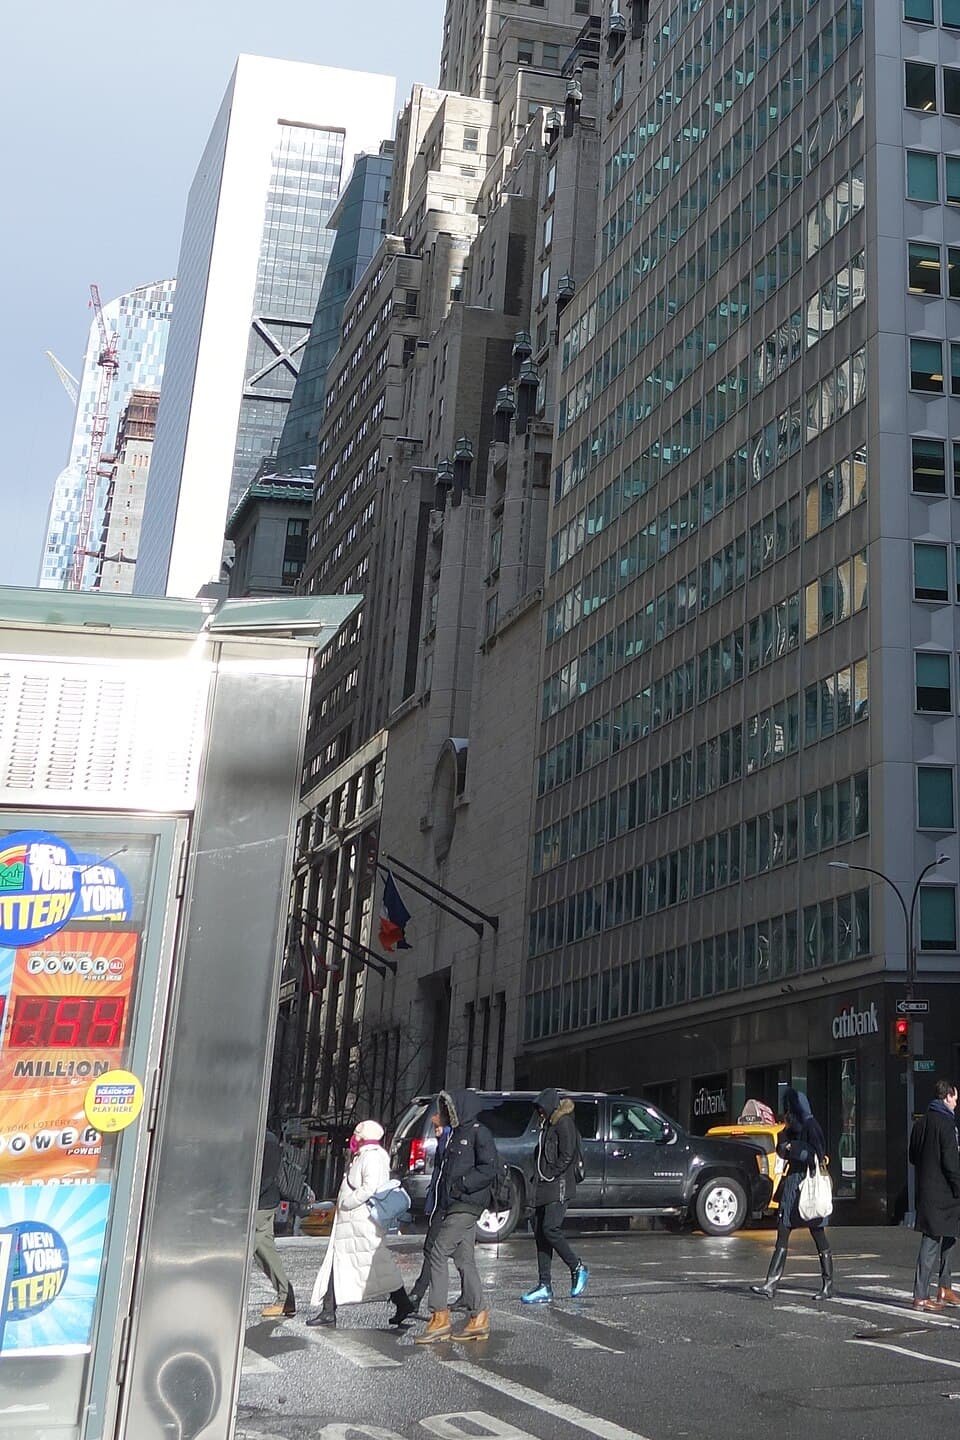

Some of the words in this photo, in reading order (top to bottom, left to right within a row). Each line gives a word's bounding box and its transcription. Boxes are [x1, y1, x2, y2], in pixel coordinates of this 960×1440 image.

[29, 844, 67, 865] NEW
[29, 864, 74, 891] YORK
[81, 865, 116, 885] NEW
[0, 892, 76, 930] TTERY
[81, 885, 124, 913] YORK
[833, 1002, 878, 1039] citibank
[14, 1060, 109, 1077] MILLION
[694, 1087, 727, 1116] citibank
[21, 1231, 55, 1250] NEW
[24, 1248, 62, 1274] YORK
